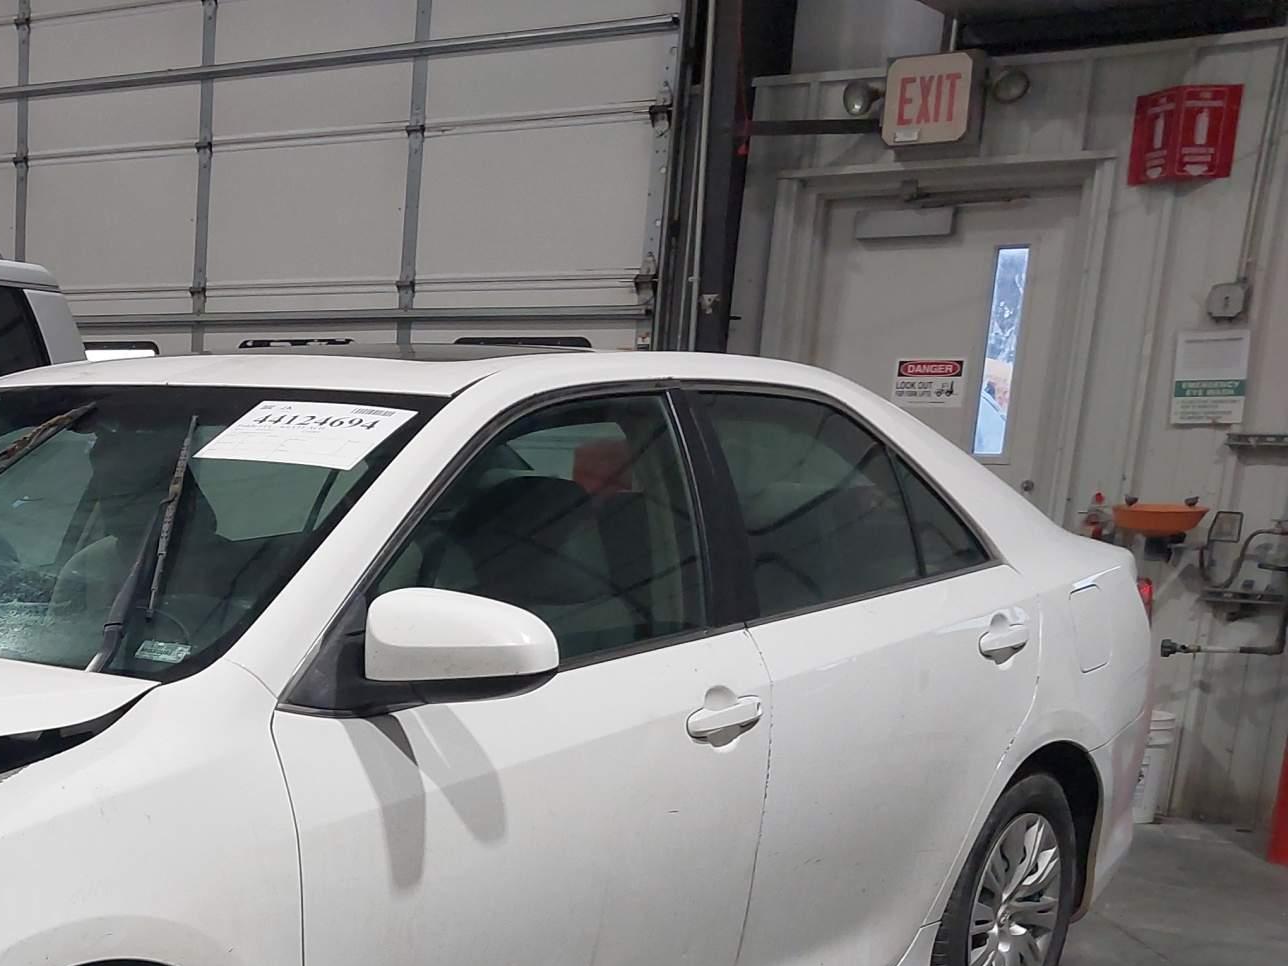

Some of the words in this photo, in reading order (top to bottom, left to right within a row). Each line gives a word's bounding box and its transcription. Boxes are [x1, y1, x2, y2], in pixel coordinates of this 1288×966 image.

[896, 72, 963, 127] EXIT
[907, 364, 954, 374] DANGER
[253, 413, 381, 431] 44124694
